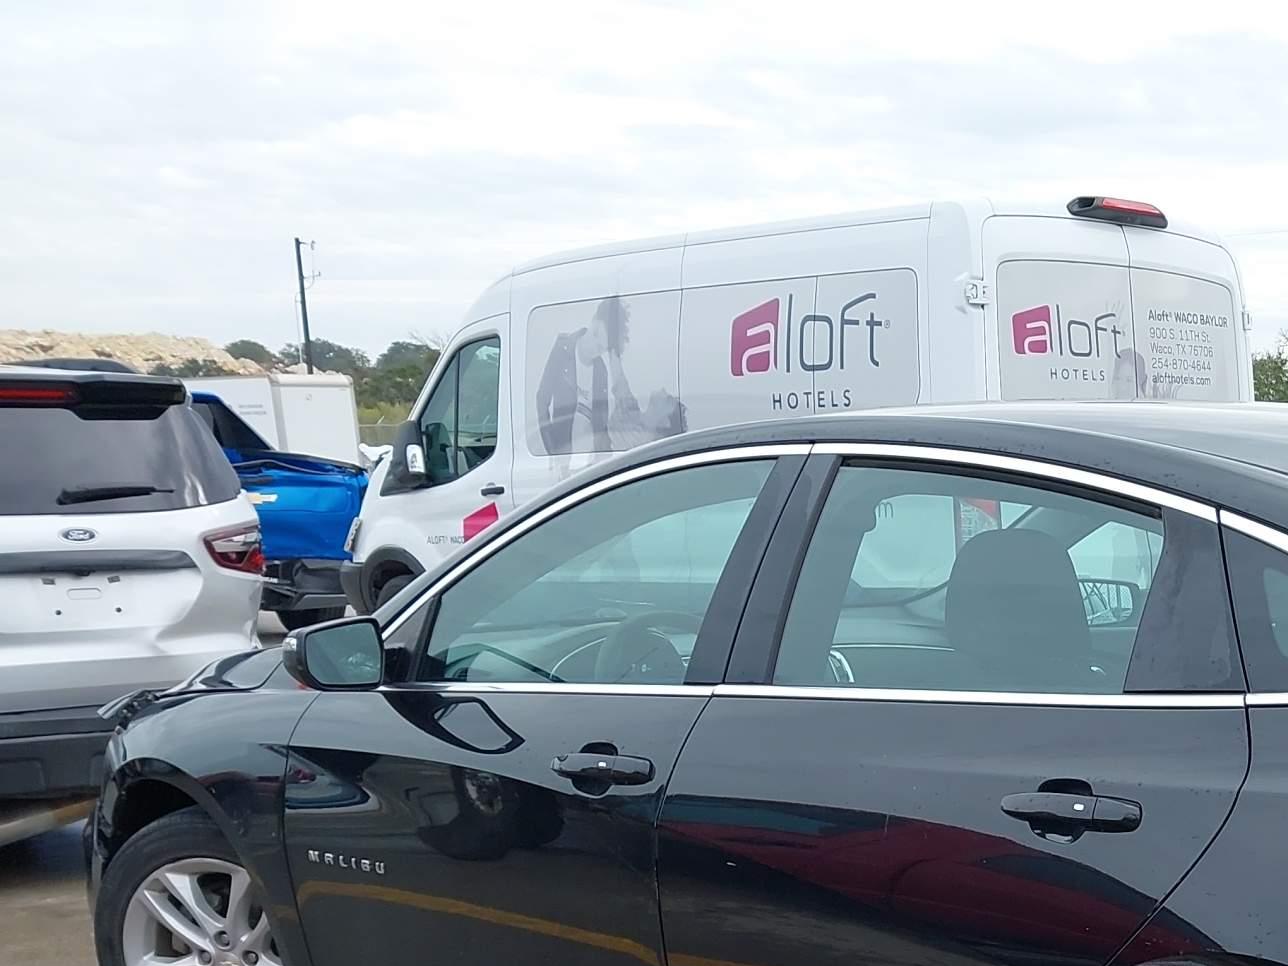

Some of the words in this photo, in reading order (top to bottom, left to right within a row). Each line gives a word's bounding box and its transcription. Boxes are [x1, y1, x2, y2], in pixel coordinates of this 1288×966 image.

[1174, 311, 1199, 325] WACO
[1200, 314, 1228, 328] BAYLOR
[1149, 327, 1167, 340] 900
[1180, 329, 1200, 343] 11TH
[1150, 342, 1174, 356] Waco,
[1176, 344, 1187, 356] TX
[1188, 345, 1214, 358] 76706
[1050, 368, 1105, 381] HOTELS
[1151, 372, 1211, 386] alofthotels.com
[772, 389, 852, 410] HOTELS
[308, 850, 385, 874] MALIBU
